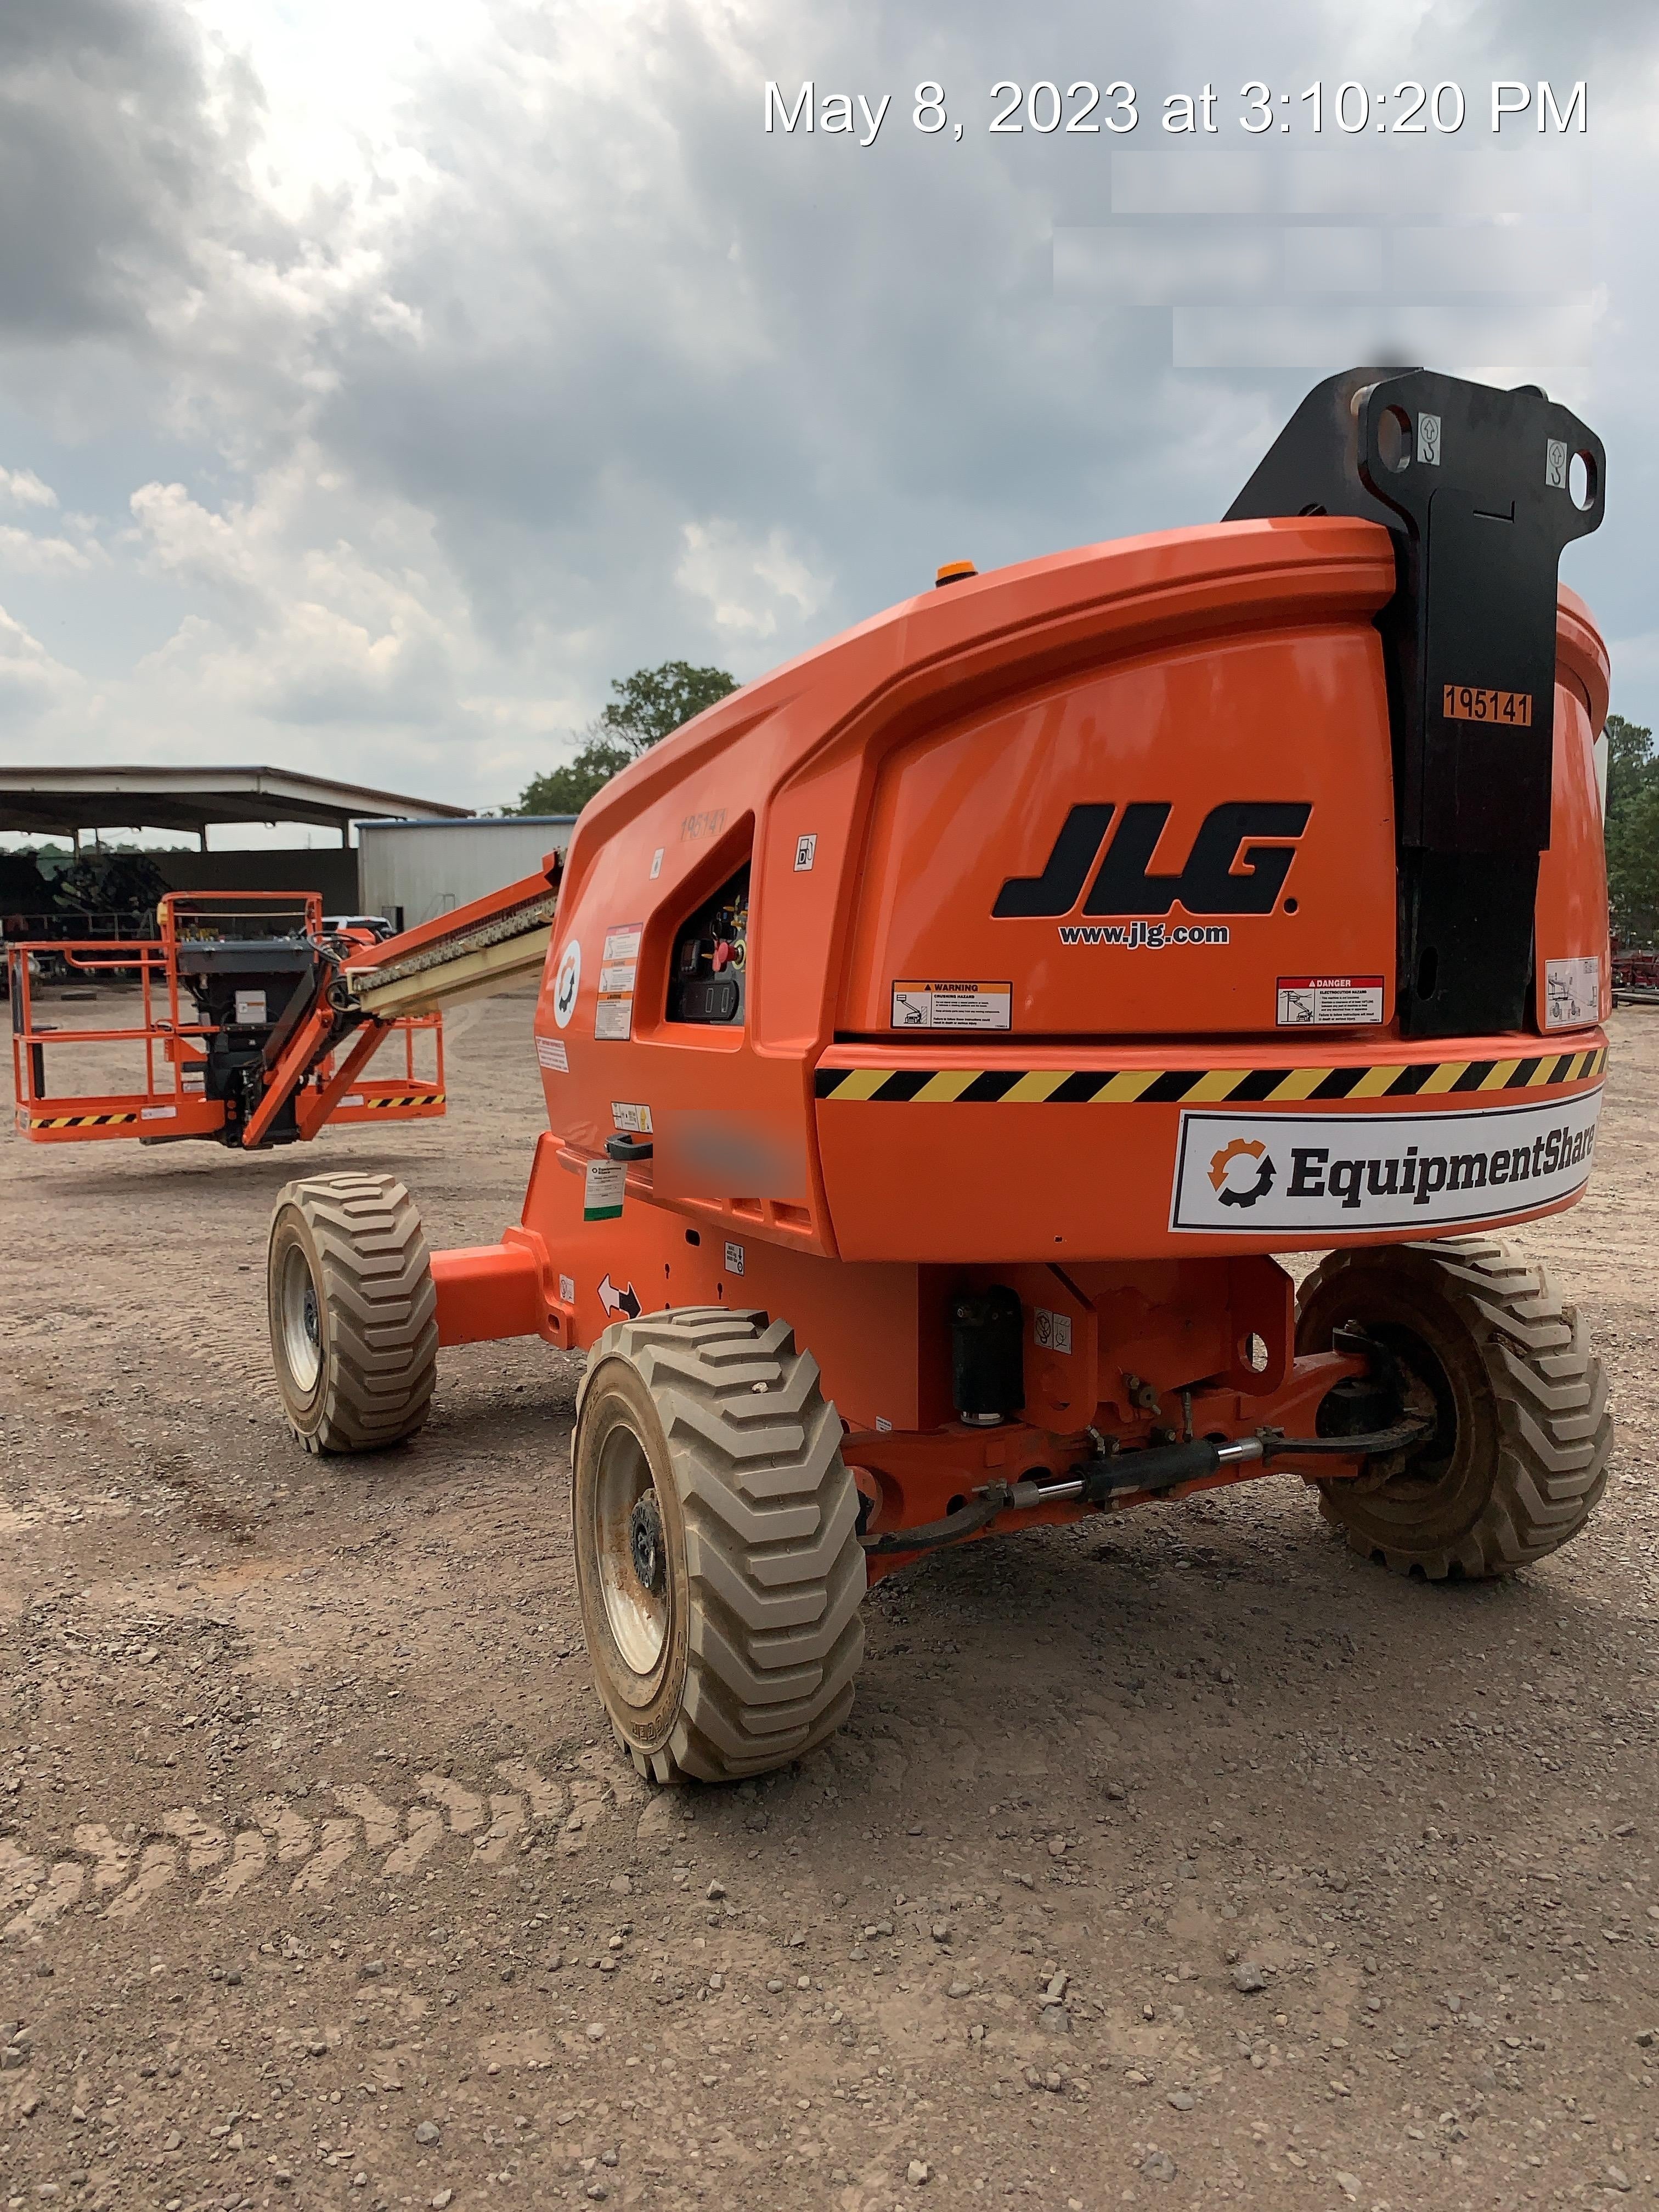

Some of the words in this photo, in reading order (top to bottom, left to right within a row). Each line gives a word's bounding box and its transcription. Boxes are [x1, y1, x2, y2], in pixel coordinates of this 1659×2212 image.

[1446, 686, 1527, 723] 195141
[990, 803, 1313, 917] JLG
[1058, 921, 1229, 950] www.jlg.com
[1286, 1124, 1595, 1207] EquipmentShare
